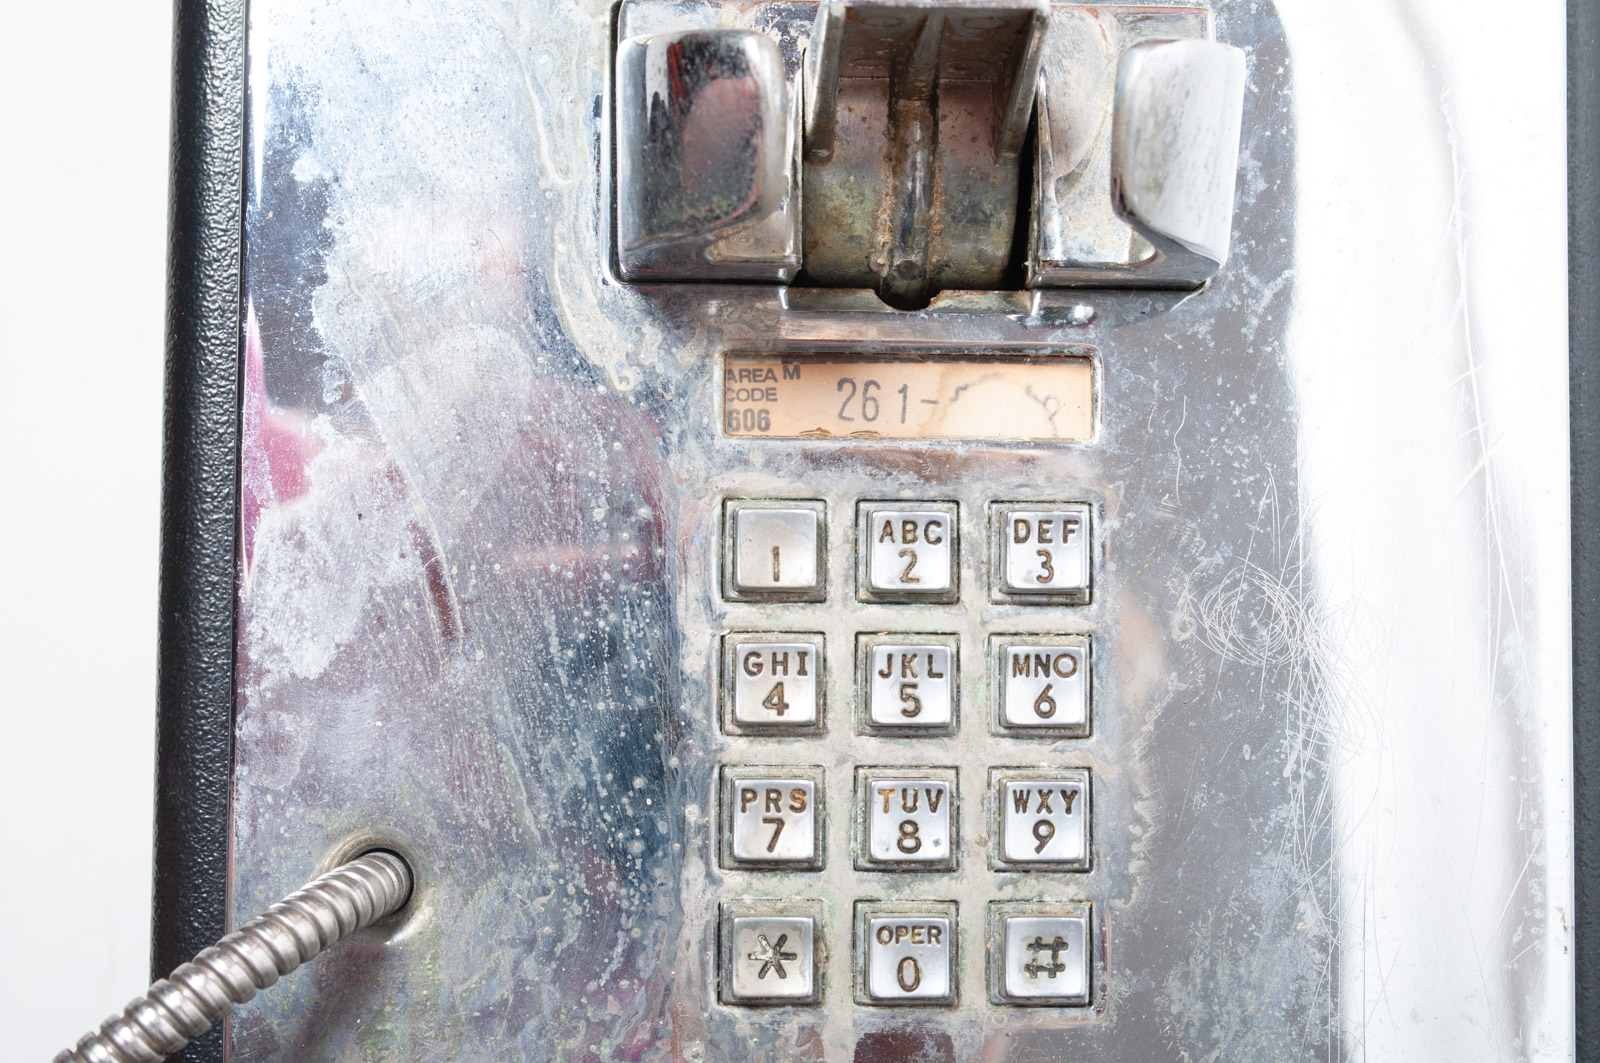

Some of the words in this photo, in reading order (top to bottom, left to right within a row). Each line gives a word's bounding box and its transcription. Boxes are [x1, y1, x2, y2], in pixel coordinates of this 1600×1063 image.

[727, 368, 778, 383] AREA
[782, 364, 801, 381] M
[727, 387, 778, 403] CODE
[727, 408, 771, 433] 606
[879, 519, 943, 545] ABC
[1014, 519, 1080, 545] DEF
[772, 546, 781, 582] 1
[898, 549, 920, 583] 2
[1036, 549, 1054, 584] 3
[743, 651, 808, 677] GHI
[878, 653, 944, 679] JKL
[1012, 652, 1079, 678] MNO
[762, 681, 790, 716] 4
[899, 682, 922, 718] 5
[1034, 683, 1056, 719] 6
[741, 788, 808, 814] PRS
[877, 788, 944, 814] TUV
[1012, 789, 1079, 814] WXY
[762, 817, 786, 852] 7
[897, 819, 920, 854] 8
[1032, 818, 1056, 854] 9
[876, 925, 943, 947] OPER
[896, 956, 921, 993] 0
